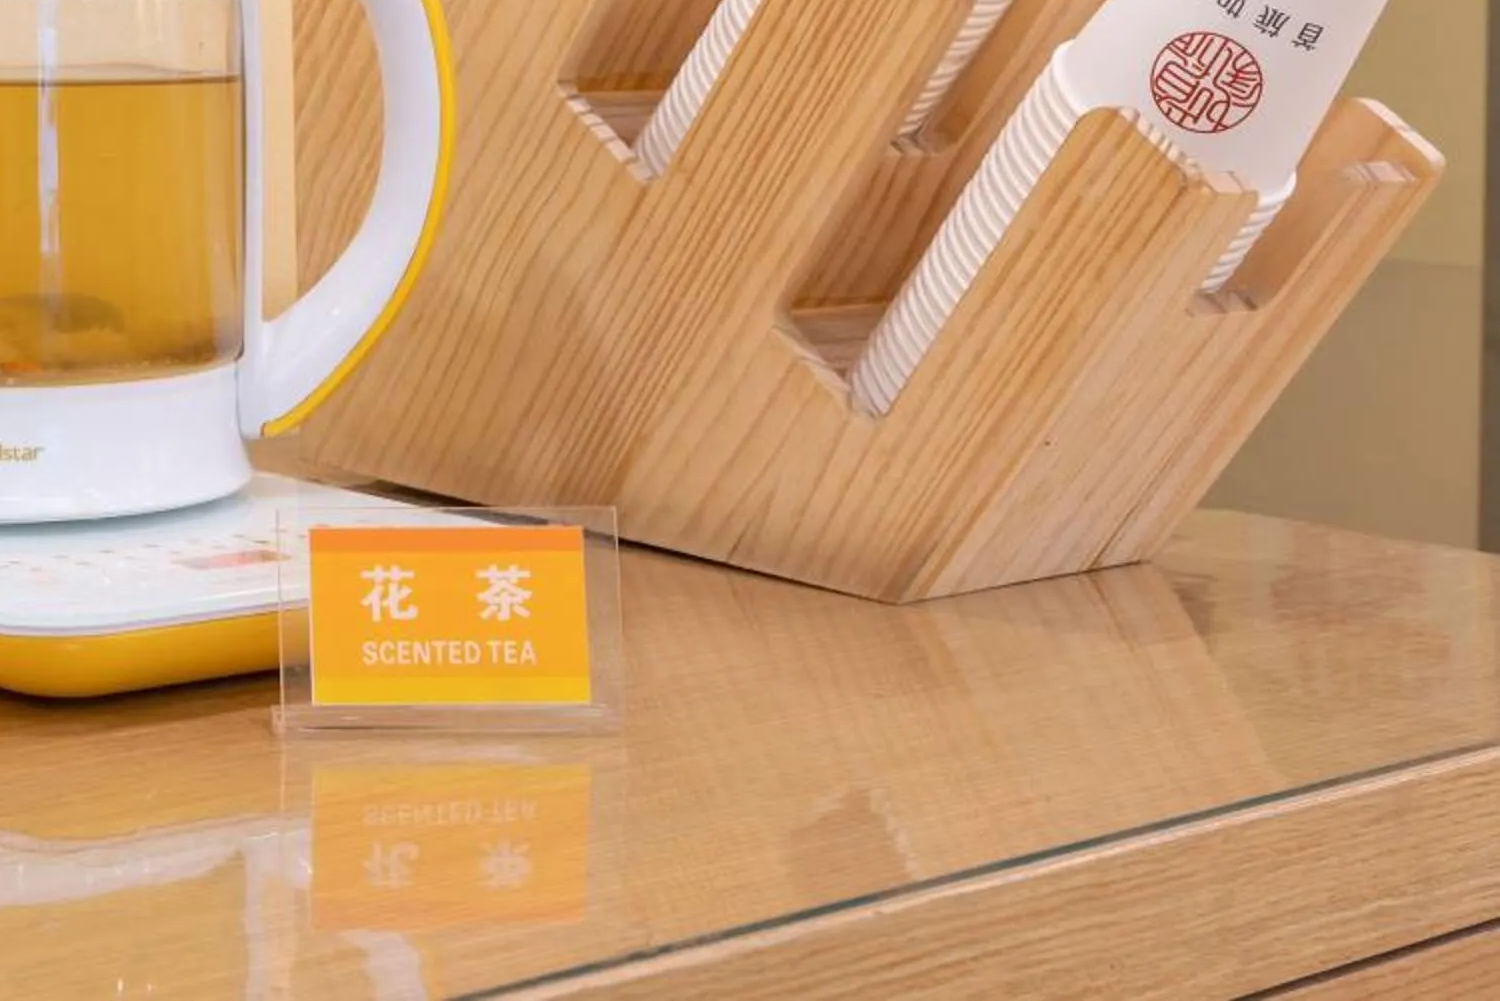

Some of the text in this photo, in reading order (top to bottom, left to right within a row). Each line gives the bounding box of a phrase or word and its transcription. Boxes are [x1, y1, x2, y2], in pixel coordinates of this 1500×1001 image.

[360, 564, 533, 623] 花茶
[361, 640, 537, 665] SCENTED TEA
